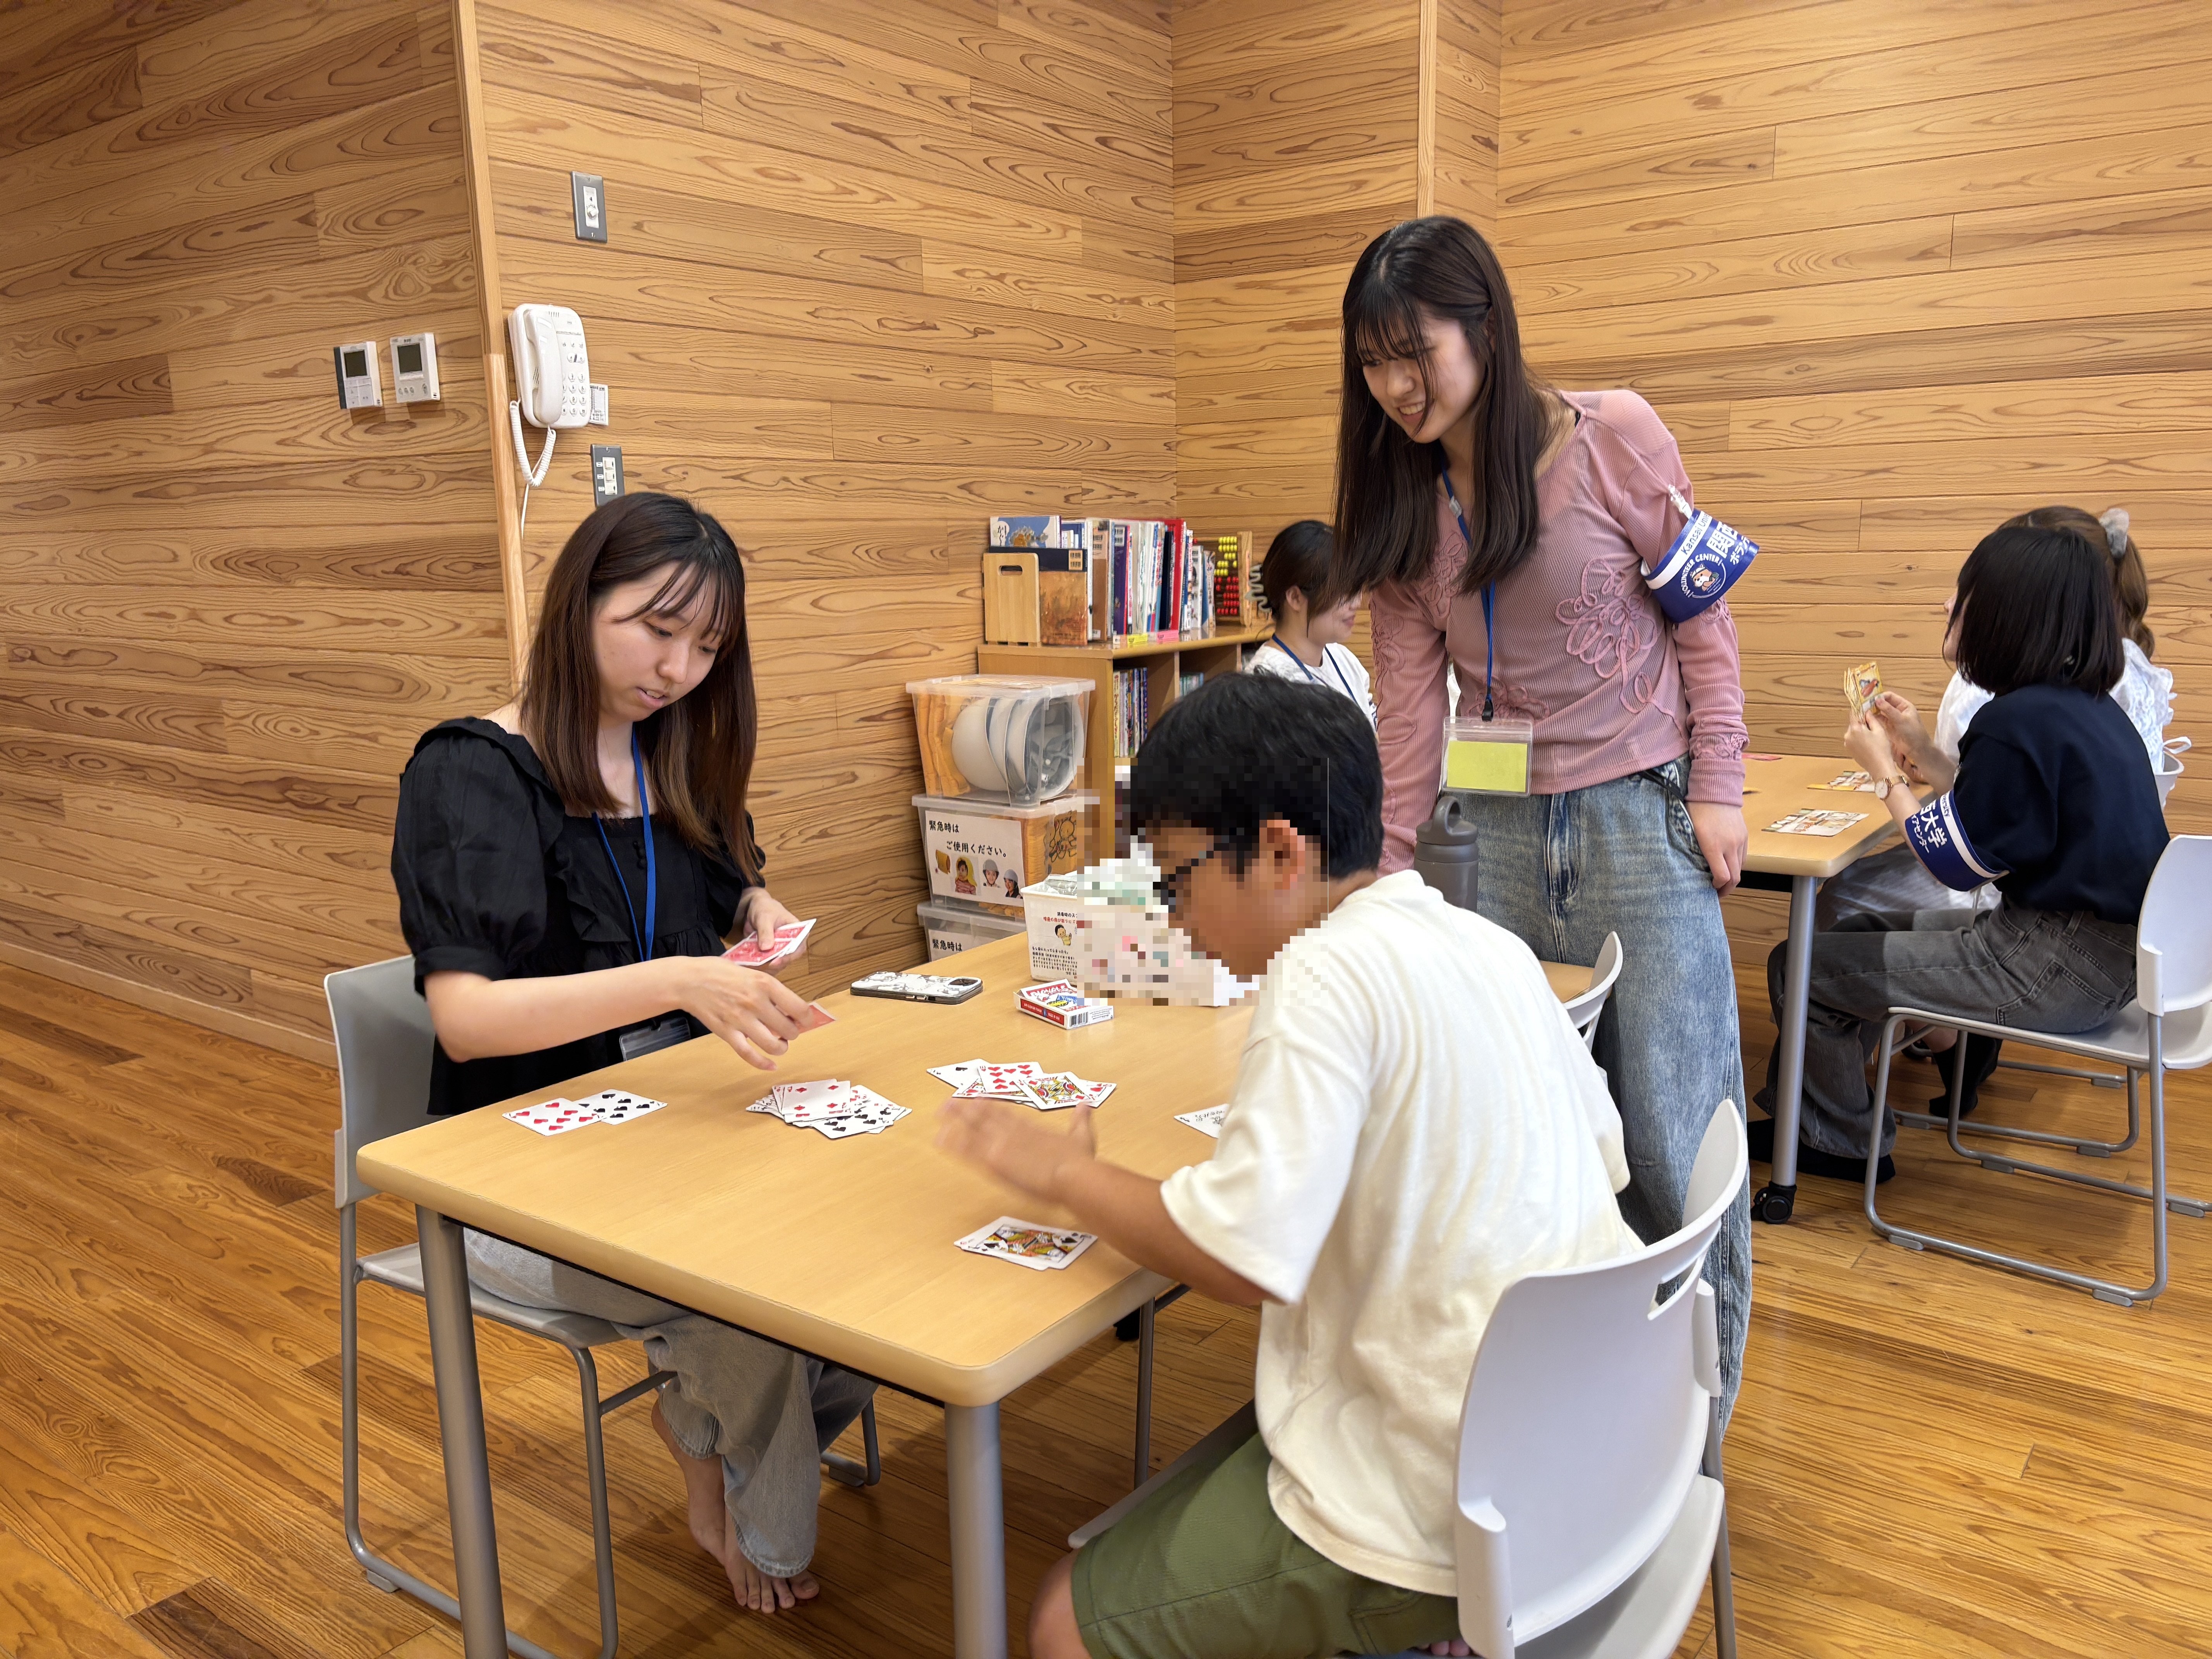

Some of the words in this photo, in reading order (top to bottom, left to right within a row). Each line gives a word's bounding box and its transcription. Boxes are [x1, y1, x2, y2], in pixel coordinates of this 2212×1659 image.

[1681, 526, 1703, 555] Kansai
[1695, 553, 1721, 563] CENTER
[929, 820, 959, 833] 緊急時は
[946, 841, 1006, 857] ご使用ください。
[933, 939, 962, 951] 緊急時は
